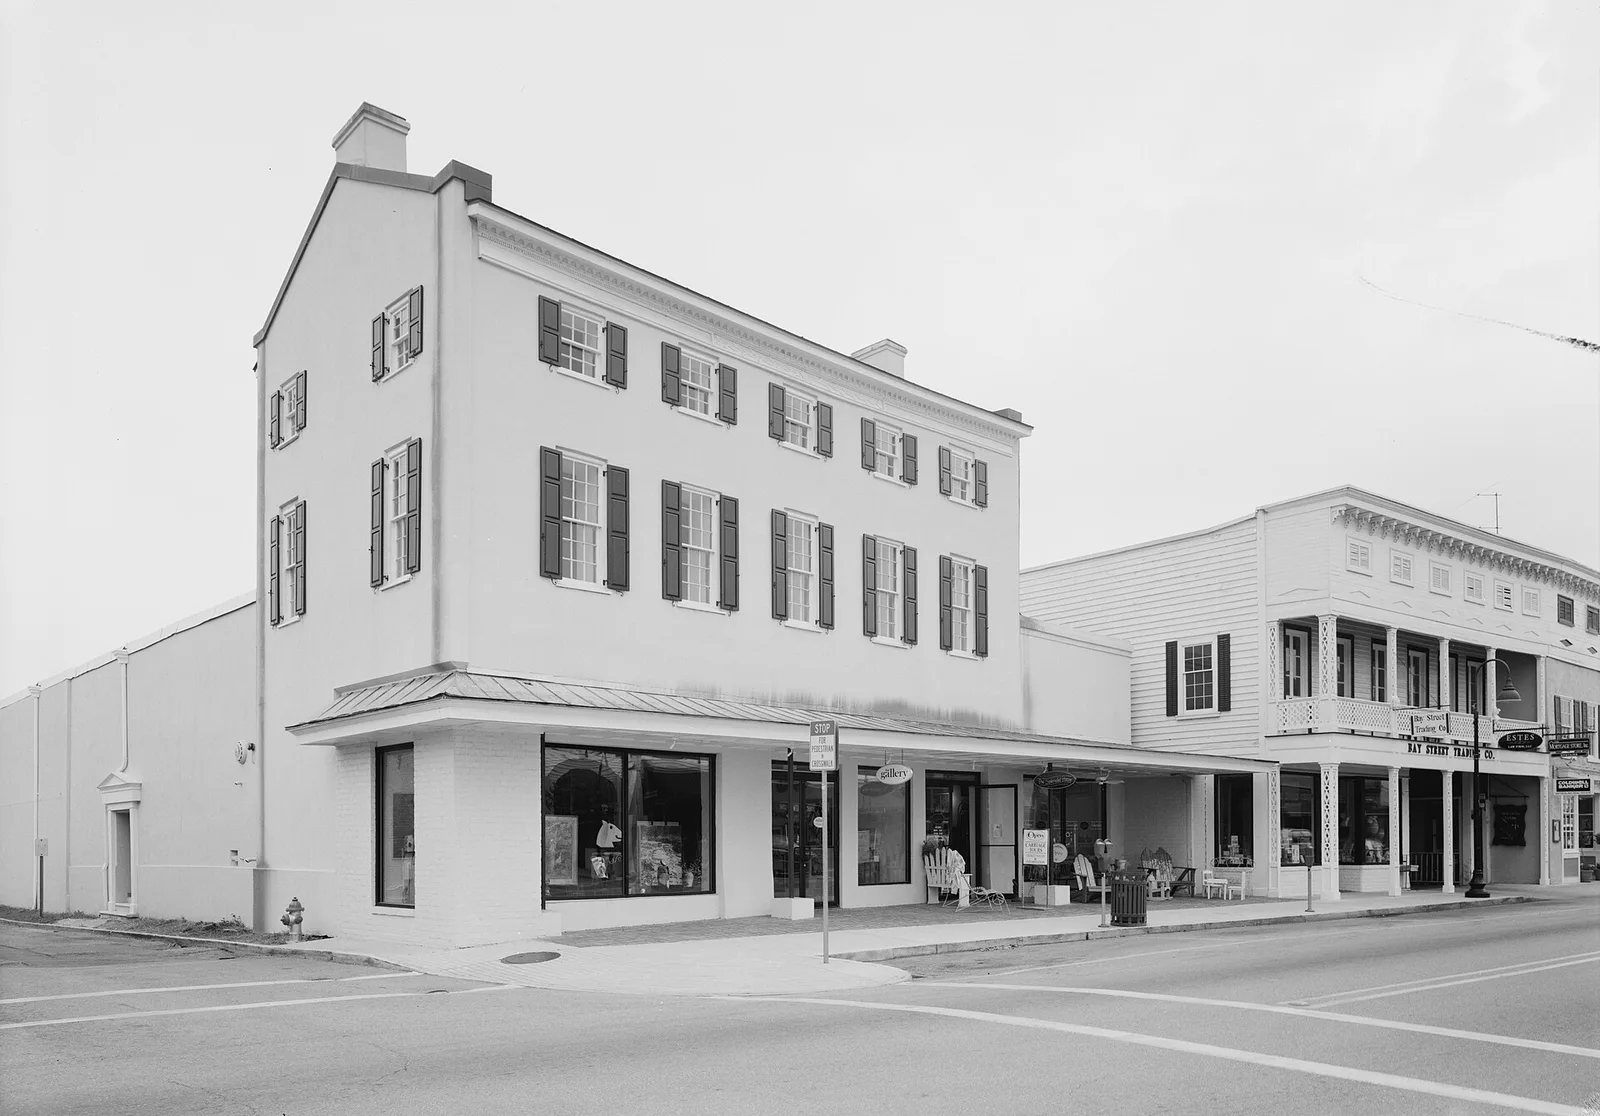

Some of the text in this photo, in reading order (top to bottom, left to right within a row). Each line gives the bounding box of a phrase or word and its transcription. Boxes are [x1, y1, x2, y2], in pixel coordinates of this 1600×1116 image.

[1414, 713, 1445, 724] Bay Street
[814, 723, 831, 734] STOP
[1415, 726, 1436, 734] Trading
[818, 736, 827, 745] FOR
[1506, 733, 1535, 742] ESTES
[811, 745, 834, 753] PEDESTRIAN
[1407, 743, 1422, 754] BAY
[1426, 745, 1449, 756] STREET
[1484, 749, 1495, 760] CO.
[811, 760, 833, 768] CROSSWALK
[880, 768, 908, 780] gallery
[1027, 831, 1044, 839] Open
